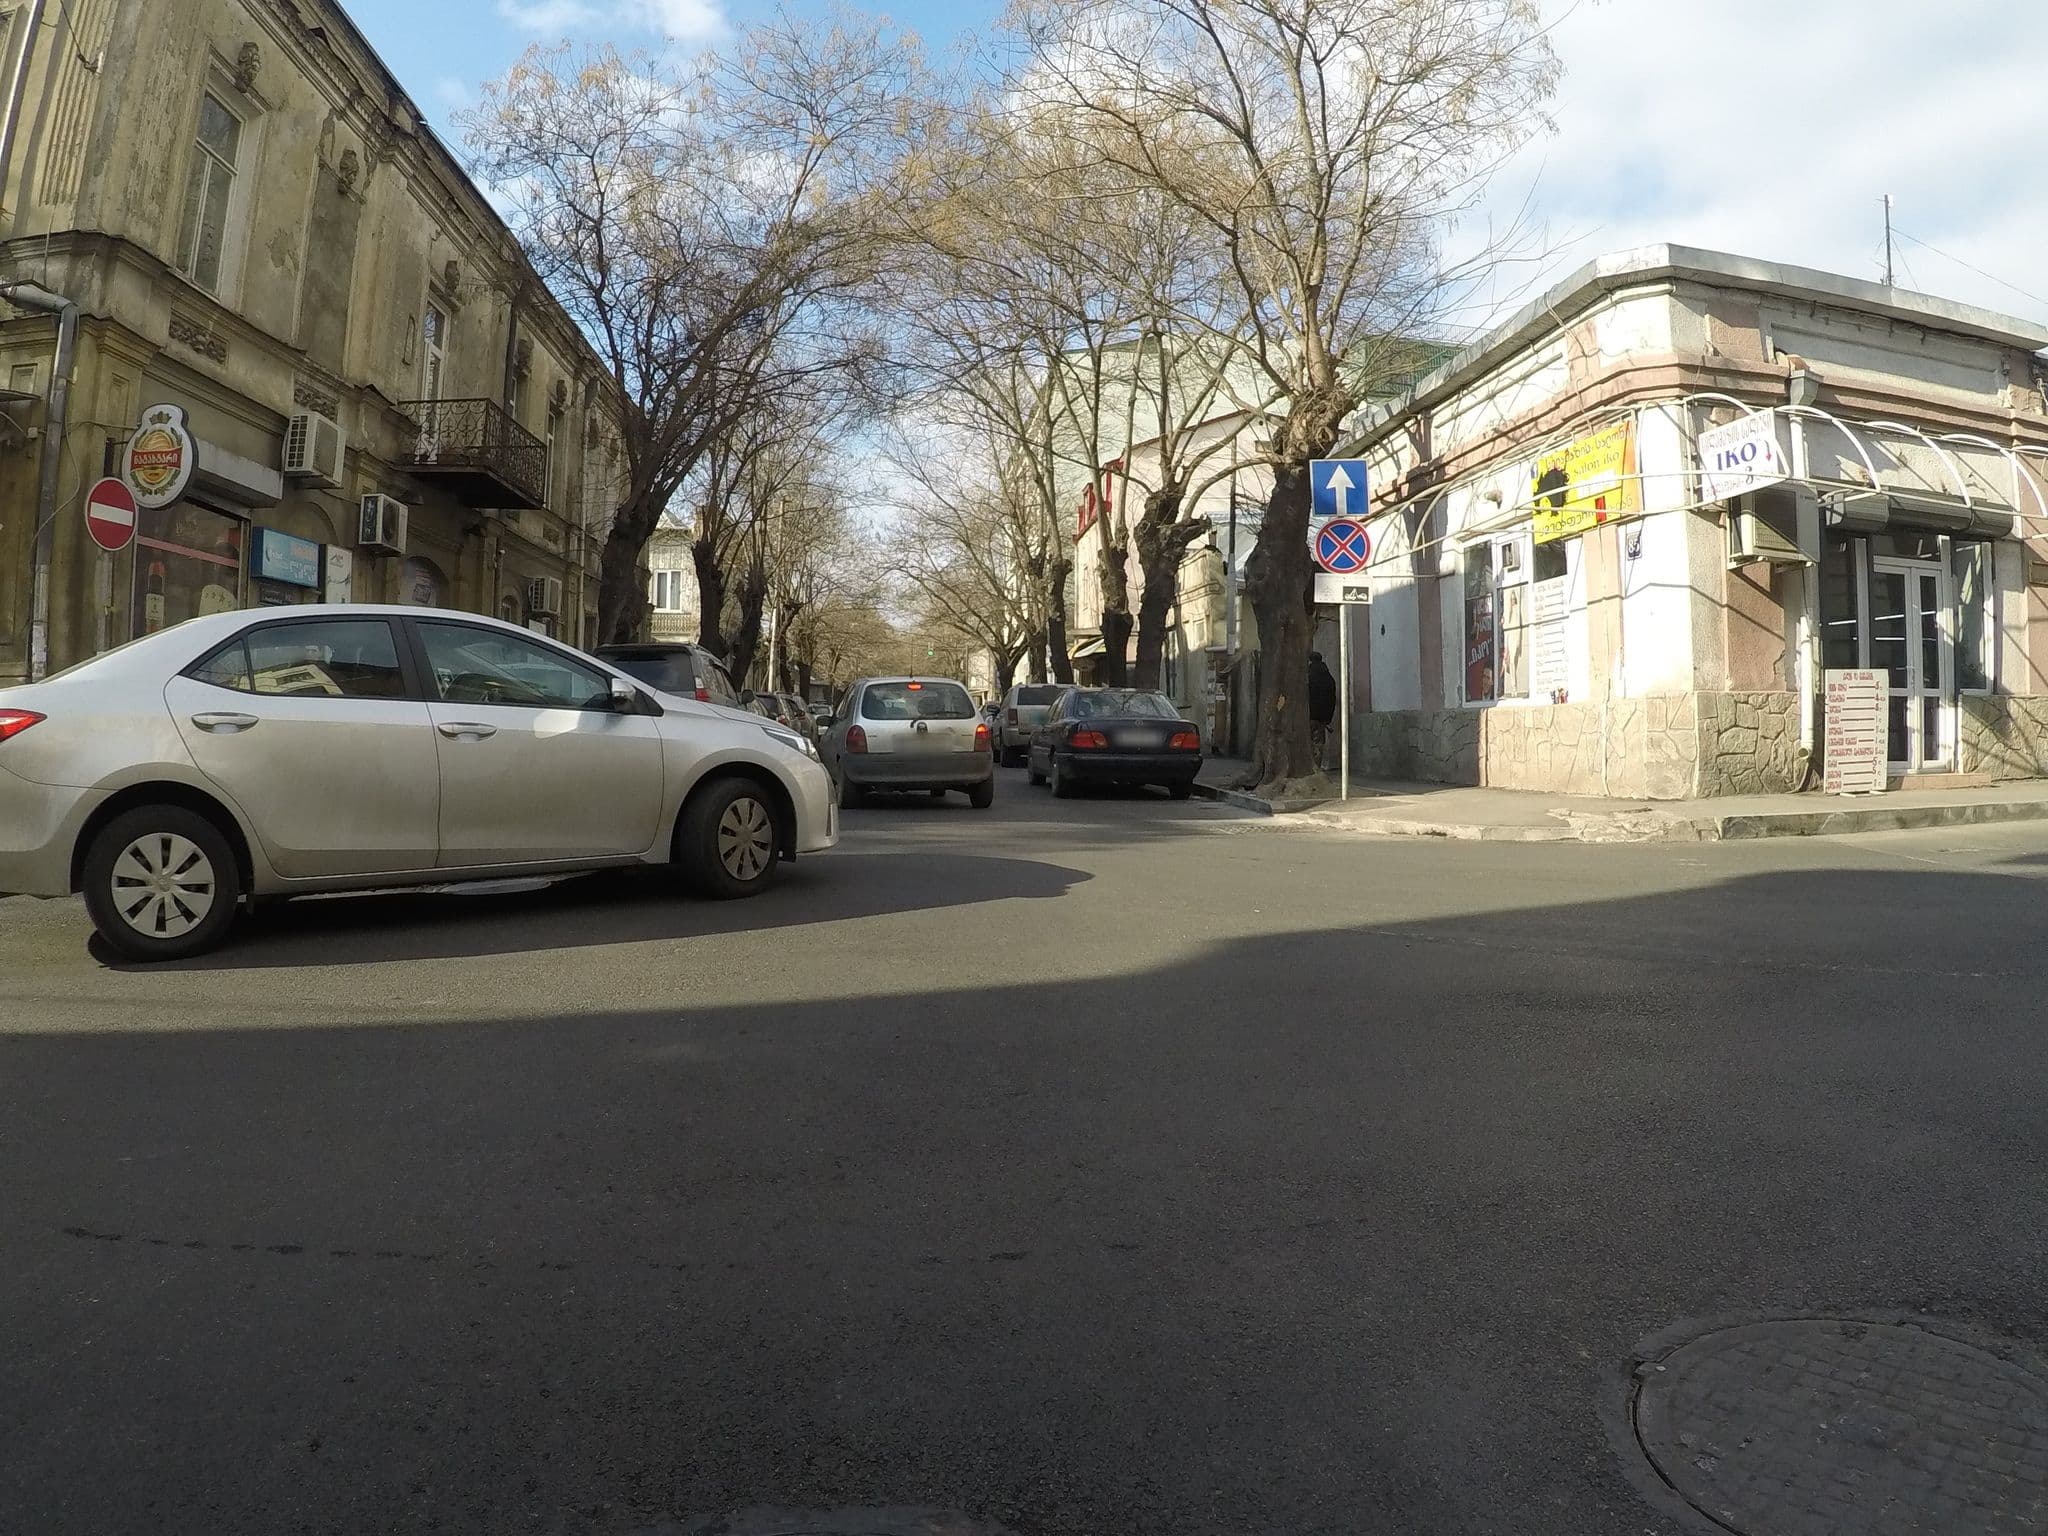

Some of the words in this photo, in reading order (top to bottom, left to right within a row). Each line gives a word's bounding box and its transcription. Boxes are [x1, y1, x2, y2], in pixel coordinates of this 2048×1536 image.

[134, 453, 178, 466] ნატახტარი
[1716, 442, 1757, 471] IKO
[1574, 459, 1601, 476] salon
